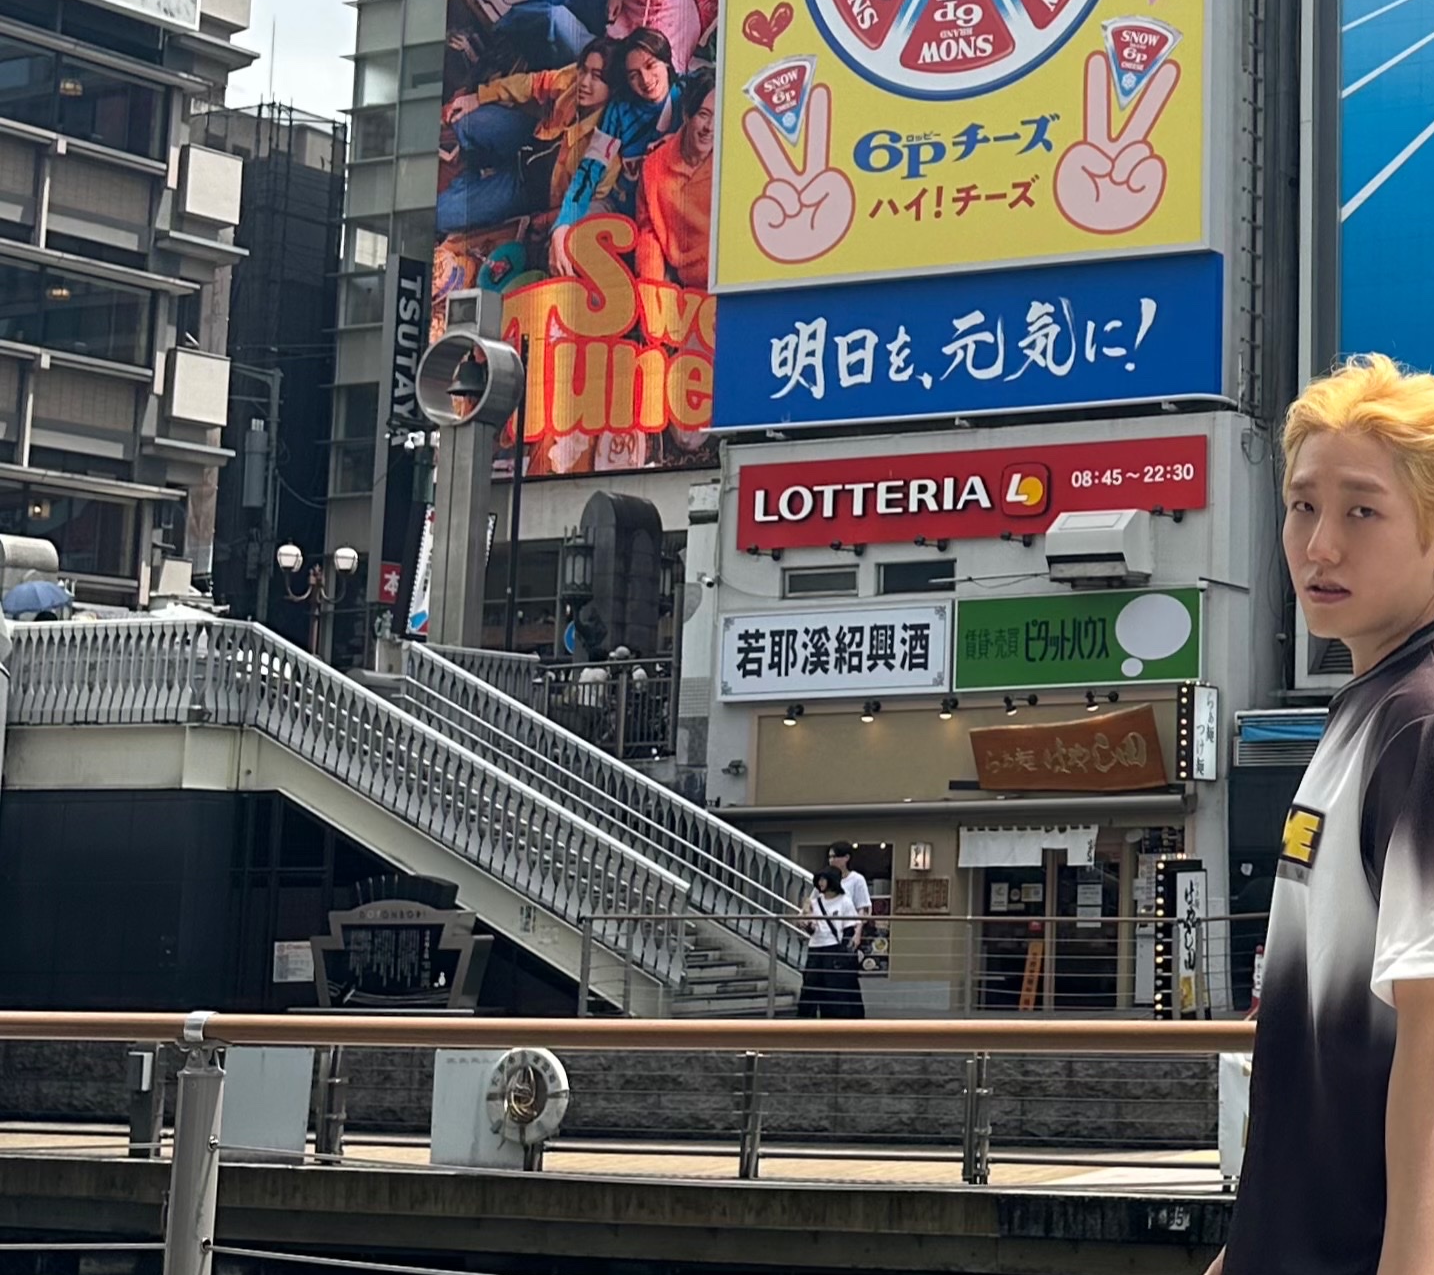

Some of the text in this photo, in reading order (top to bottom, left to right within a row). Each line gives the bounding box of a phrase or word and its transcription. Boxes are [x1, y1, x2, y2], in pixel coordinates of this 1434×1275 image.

[940, 27, 974, 39] BRAND
[1120, 29, 1160, 47] SNOW
[917, 34, 993, 64] SNOW
[763, 68, 799, 93] SNOW
[753, 475, 993, 523] LOTTERIA
[383, 571, 400, 597] 本
[736, 622, 931, 680] 若耶溪紹興酒
[964, 616, 1110, 662] 賃貸・売買 ピタットハウス
